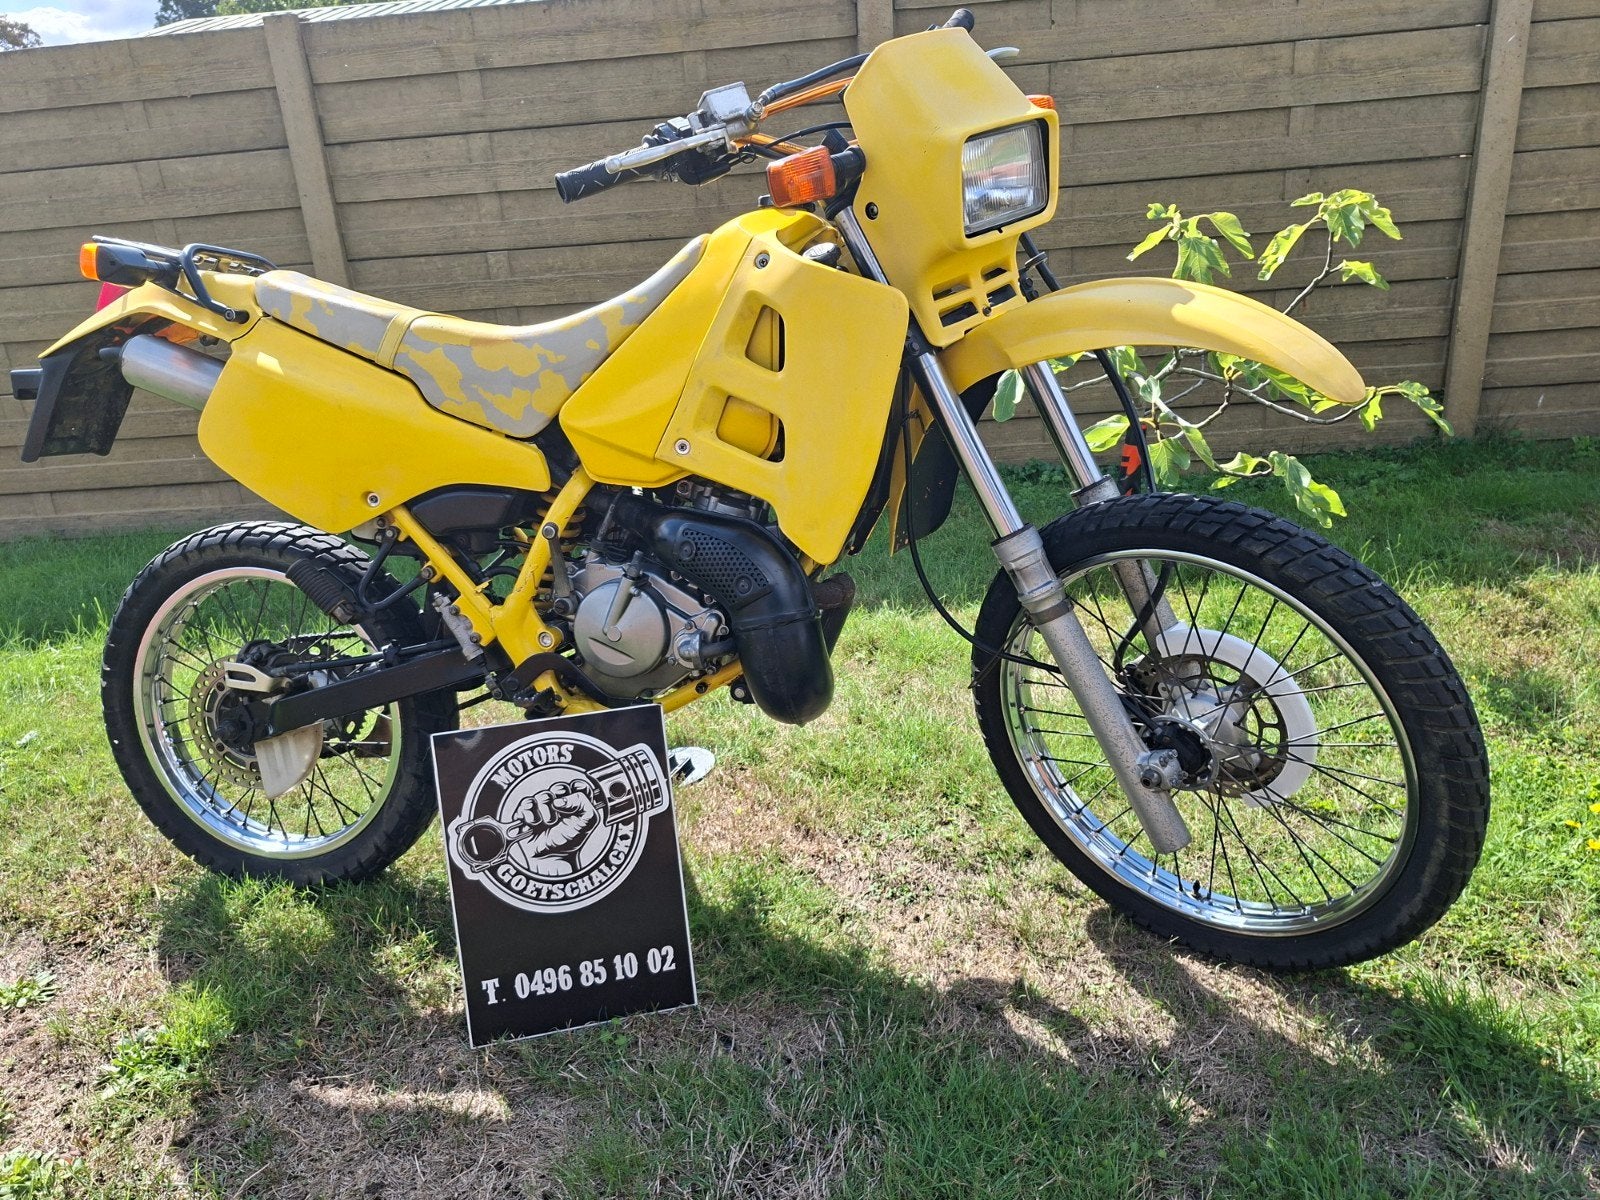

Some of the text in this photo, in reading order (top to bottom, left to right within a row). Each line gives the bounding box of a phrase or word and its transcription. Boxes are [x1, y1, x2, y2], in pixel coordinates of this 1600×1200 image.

[491, 744, 574, 789] MOTORS
[497, 821, 635, 899] GOETSCHALCKX
[481, 945, 676, 1005] T. 0496 85 10 02
